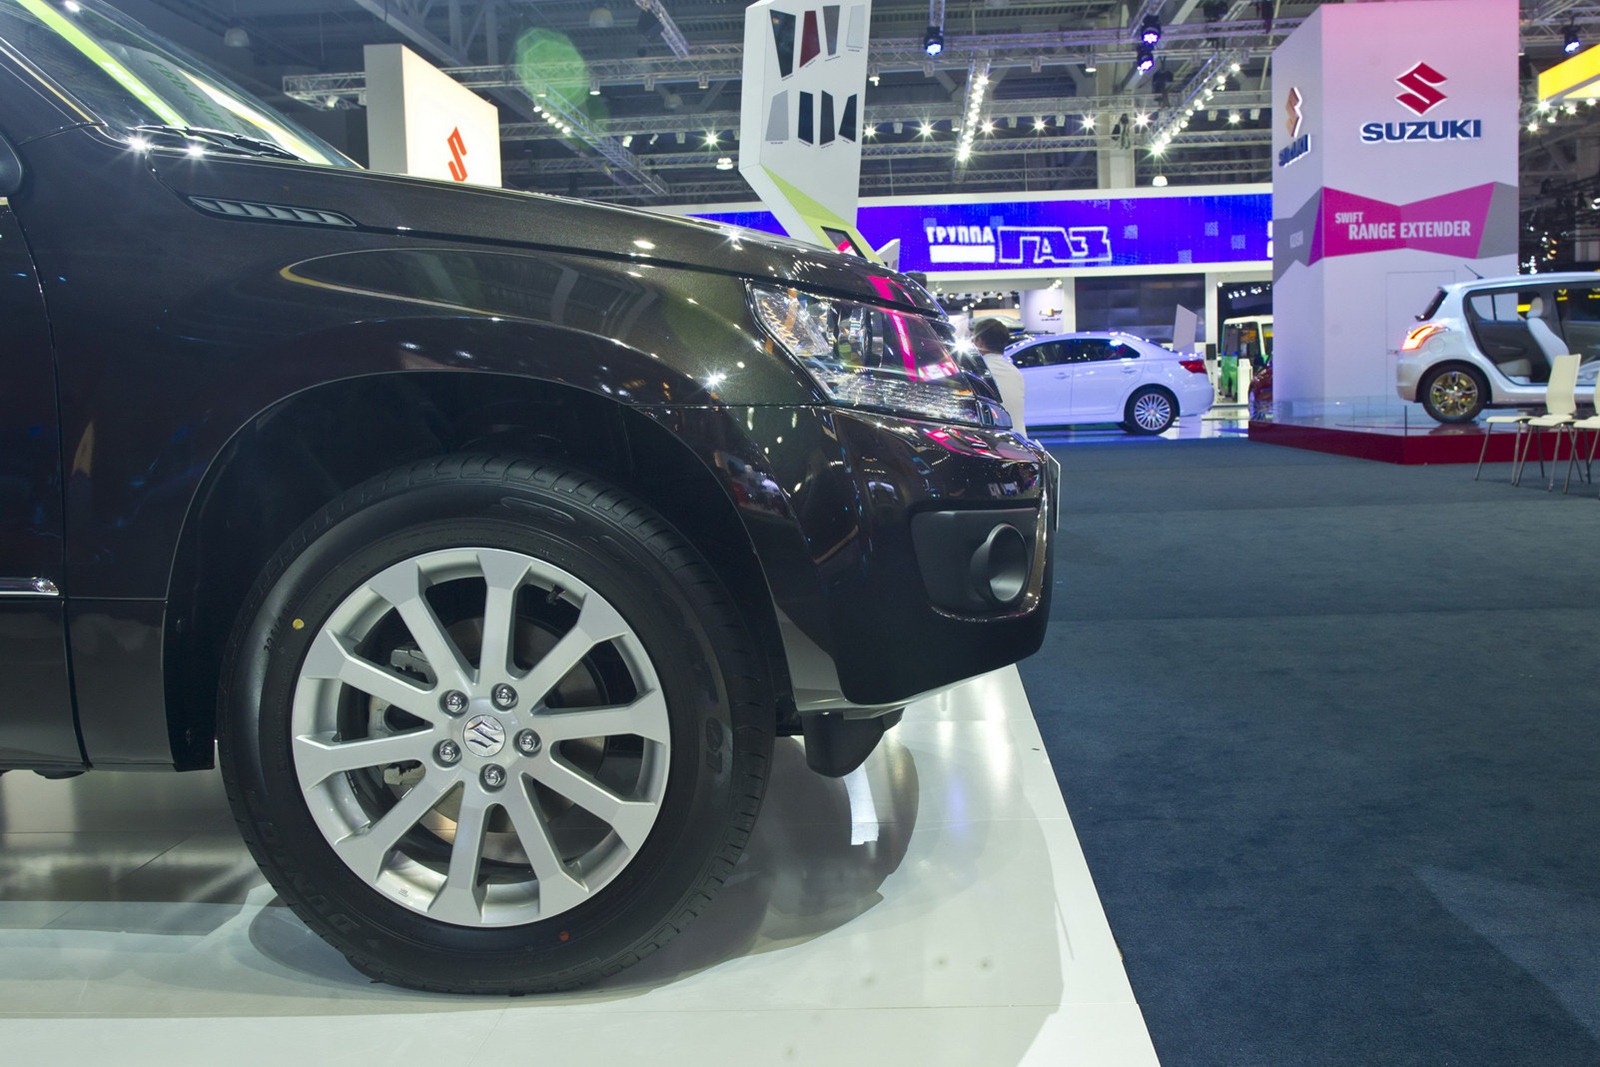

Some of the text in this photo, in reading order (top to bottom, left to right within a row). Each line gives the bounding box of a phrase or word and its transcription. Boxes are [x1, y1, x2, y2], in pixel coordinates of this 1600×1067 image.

[1361, 119, 1481, 142] SUZUKI
[1335, 212, 1363, 223] SWIFT
[1349, 221, 1471, 240] RANGE EXTENDER
[926, 226, 1112, 264] ГРУППА ГАЗ
